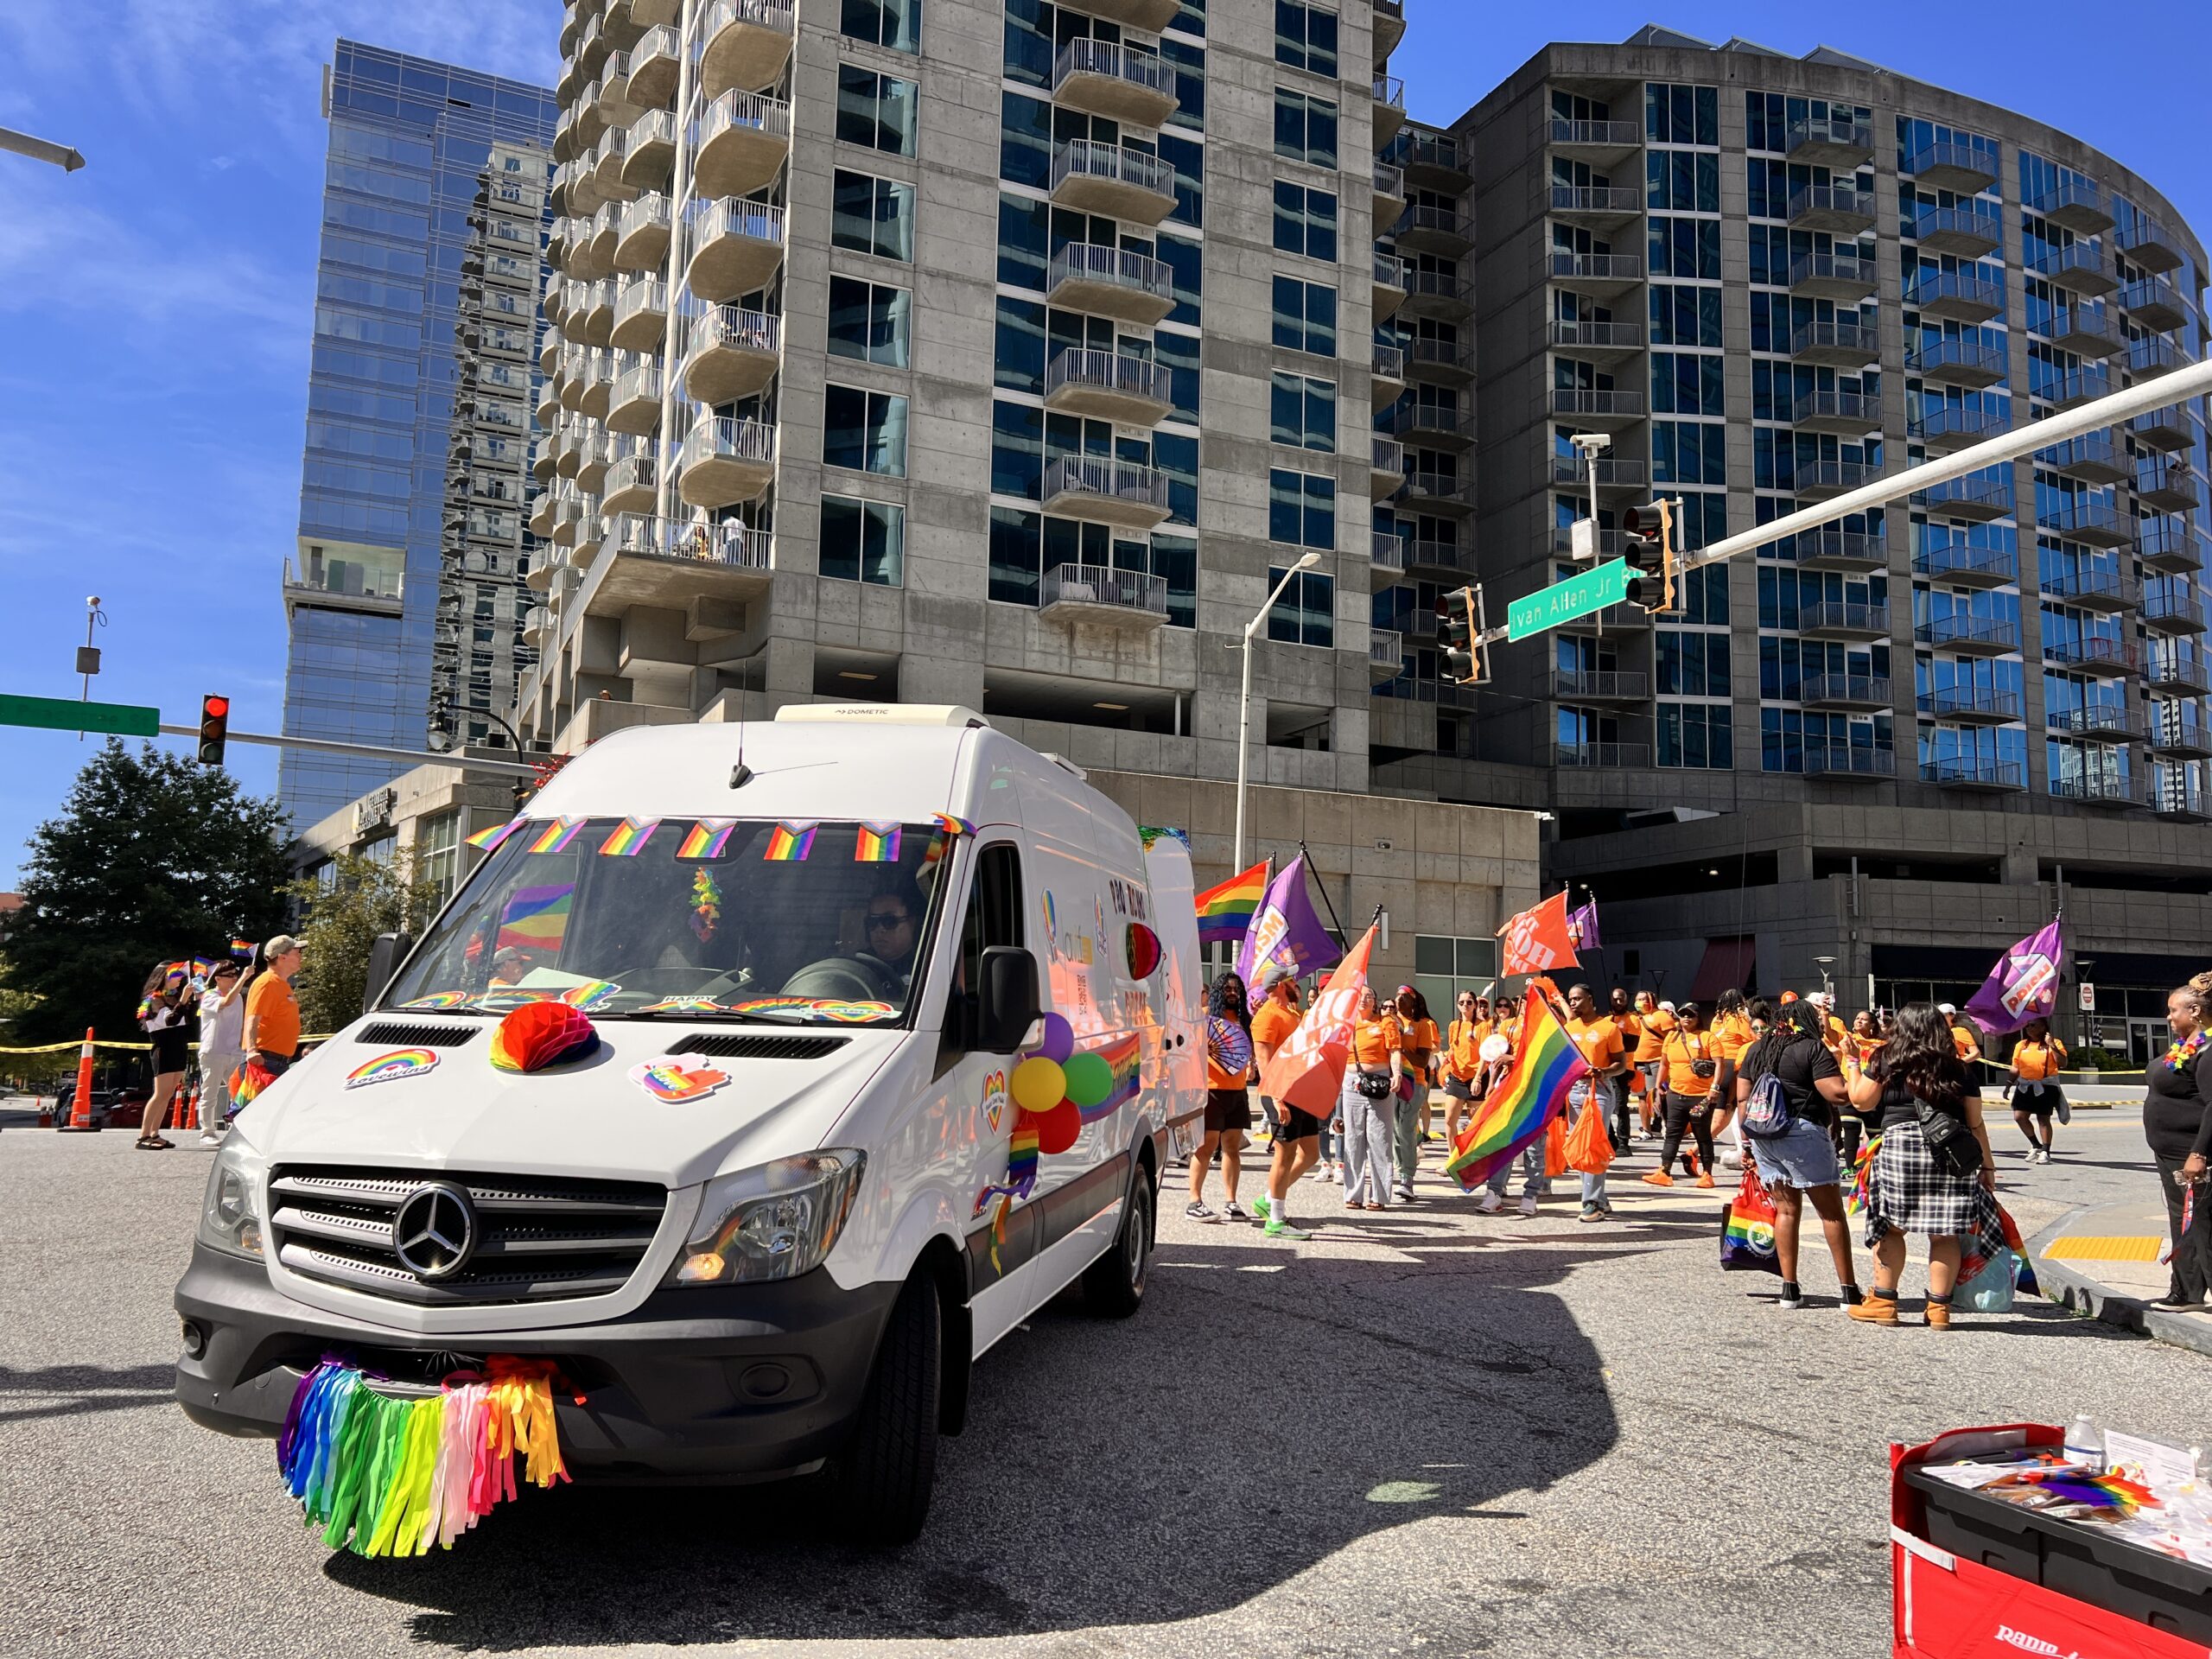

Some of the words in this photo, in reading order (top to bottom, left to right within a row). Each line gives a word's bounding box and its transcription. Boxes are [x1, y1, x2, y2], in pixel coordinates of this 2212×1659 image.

[1512, 607, 1541, 630] Ivan
[1550, 589, 1586, 615] Allen
[1596, 576, 1611, 597] Jr
[2006, 963, 2052, 1013] PRISM
[346, 1065, 429, 1086] Lovewins
[1994, 1624, 2059, 1655] RADIO
